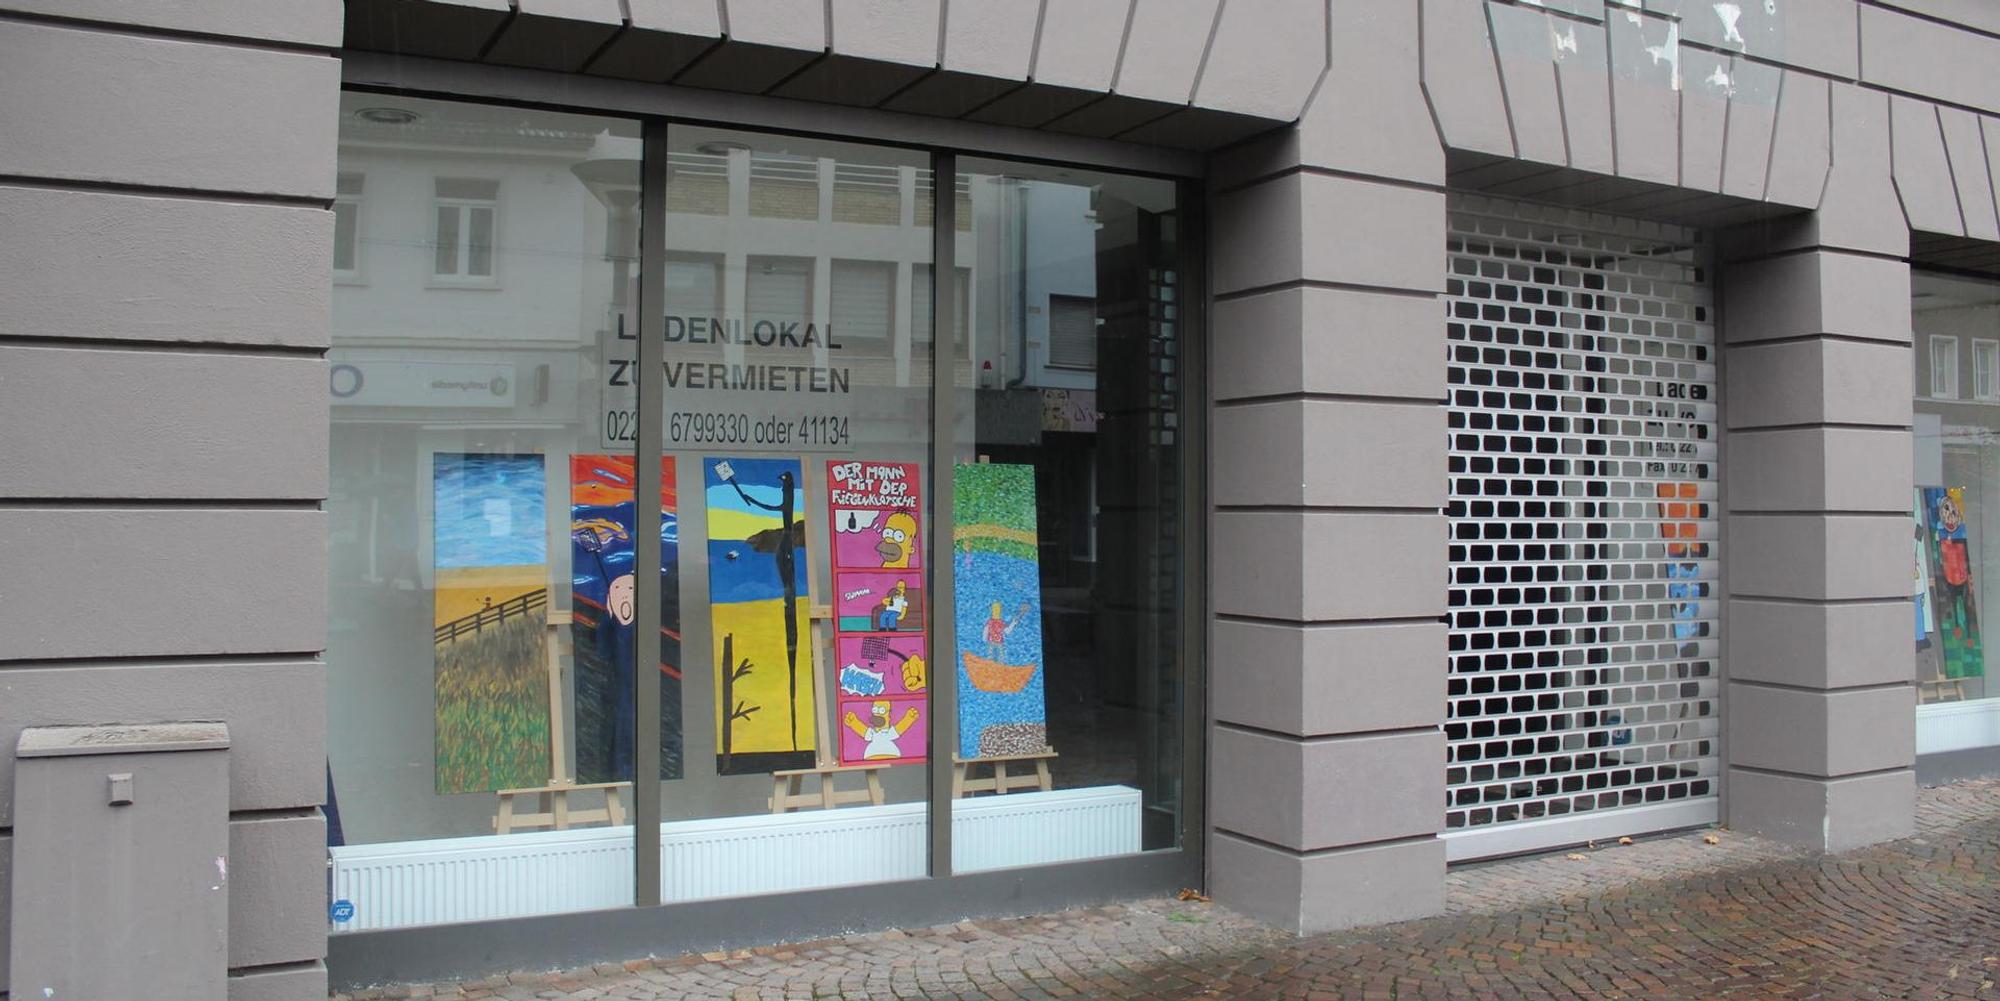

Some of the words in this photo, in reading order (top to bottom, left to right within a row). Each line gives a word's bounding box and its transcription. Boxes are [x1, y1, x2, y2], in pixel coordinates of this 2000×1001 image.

[617, 313, 842, 349] LDENLOKAL
[608, 359, 637, 387] Z
[663, 361, 849, 394] VERMIETEN
[607, 411, 637, 441] 022
[670, 412, 749, 443] 6799330
[754, 415, 794, 444] oder
[798, 416, 849, 445] 41134
[832, 462, 862, 482] DER
[866, 466, 906, 480] MANN
[879, 480, 908, 497] DER
